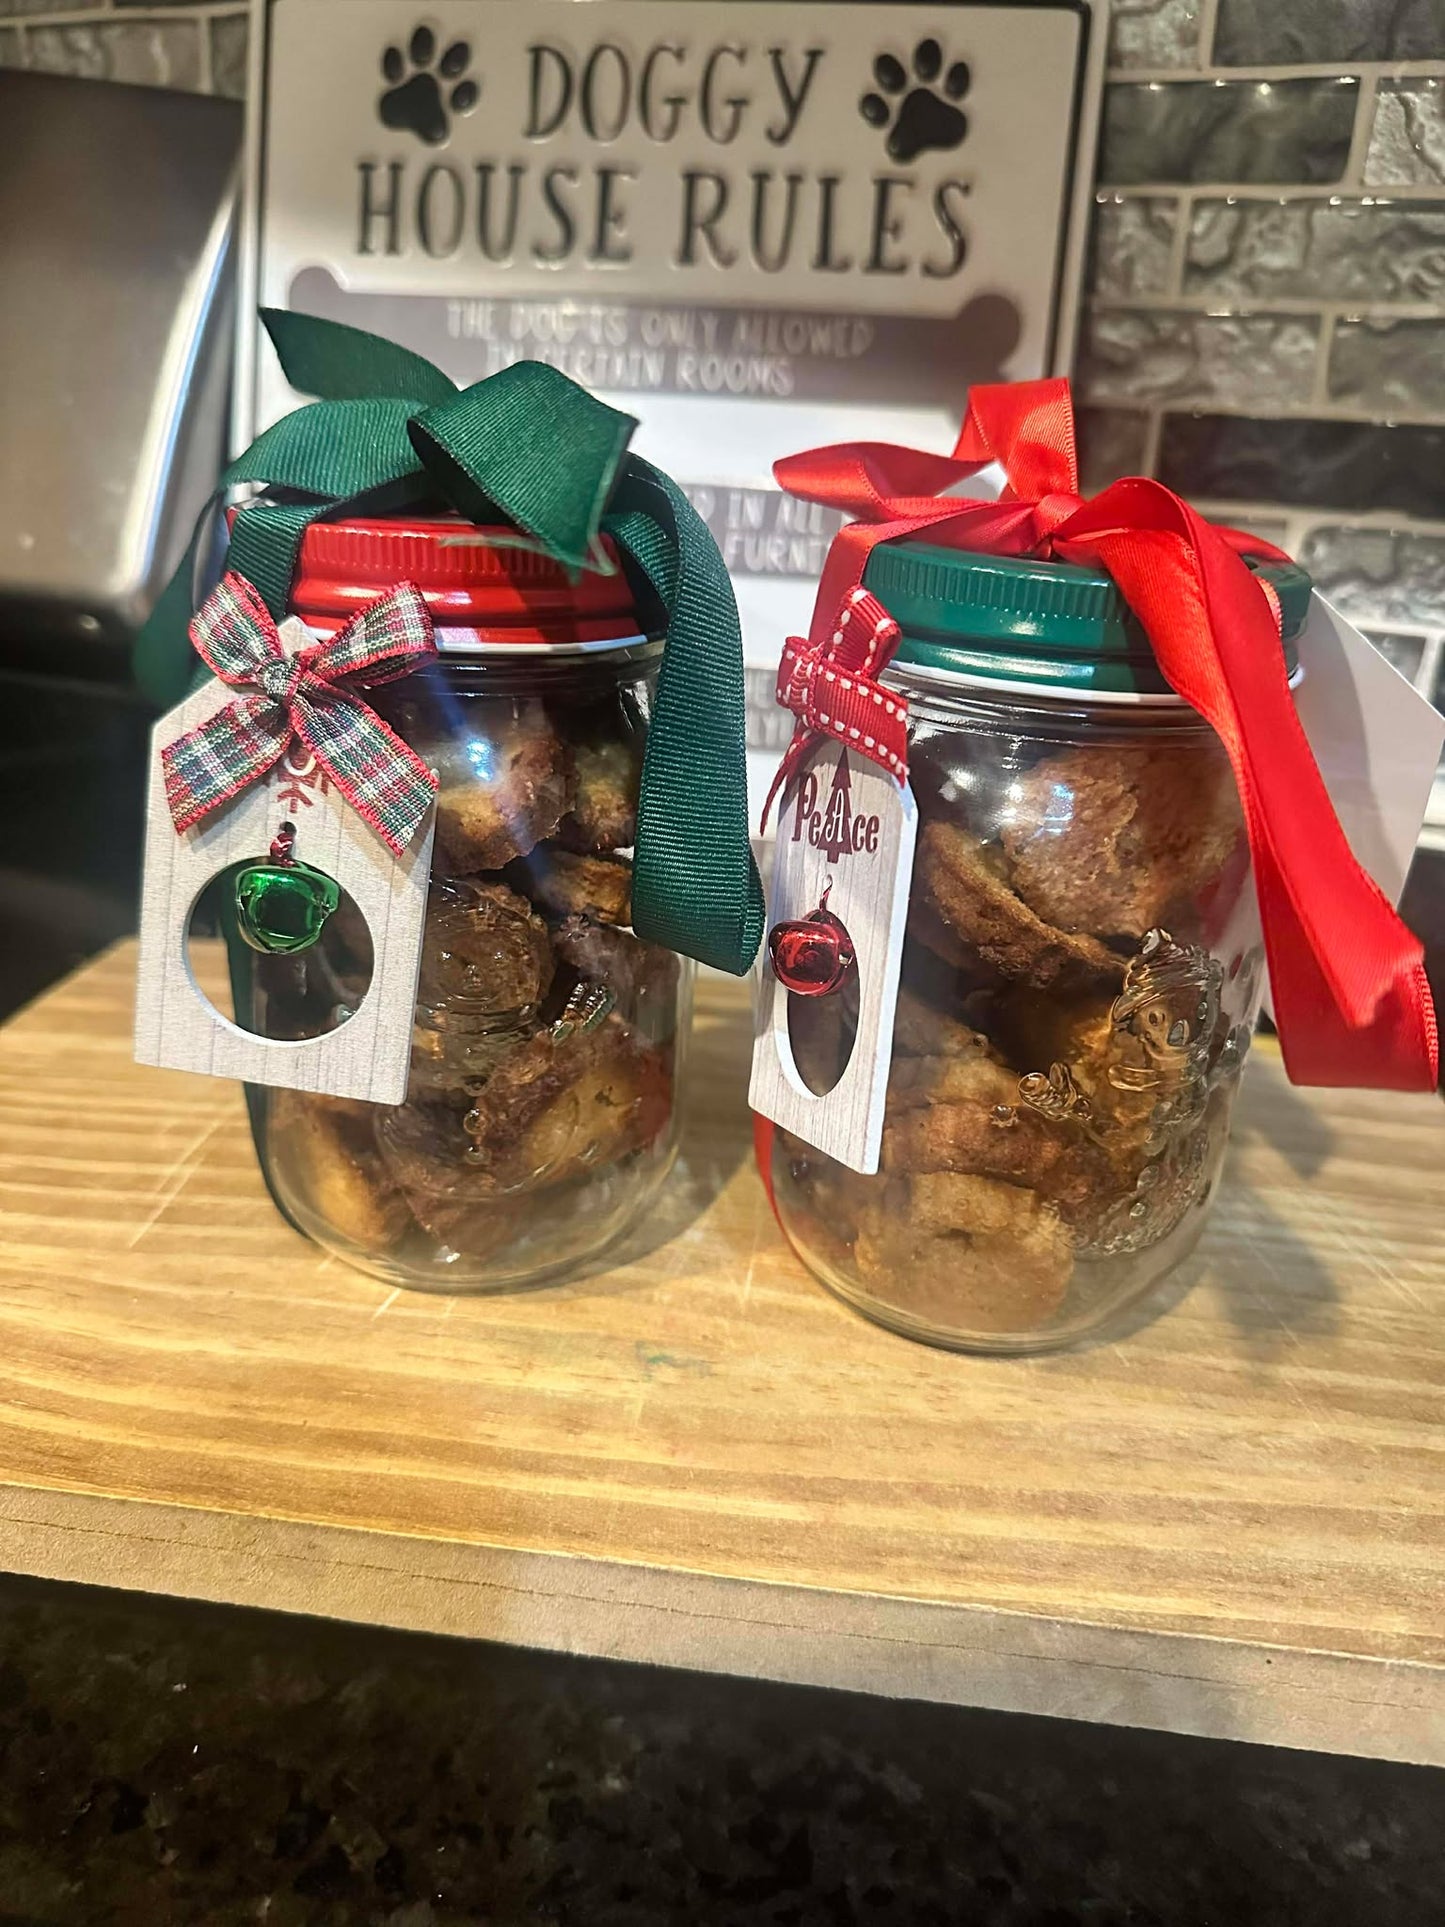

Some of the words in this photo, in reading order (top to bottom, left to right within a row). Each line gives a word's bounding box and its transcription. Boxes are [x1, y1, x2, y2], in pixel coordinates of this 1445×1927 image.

[522, 43, 825, 147] DOGGY
[356, 161, 637, 262] HOUSE
[673, 170, 973, 279] RULES
[446, 302, 496, 340] THE
[589, 305, 628, 346] IS
[638, 308, 720, 351] ONLY
[731, 312, 877, 357] ALLOWED
[675, 350, 795, 397] ROOMS
